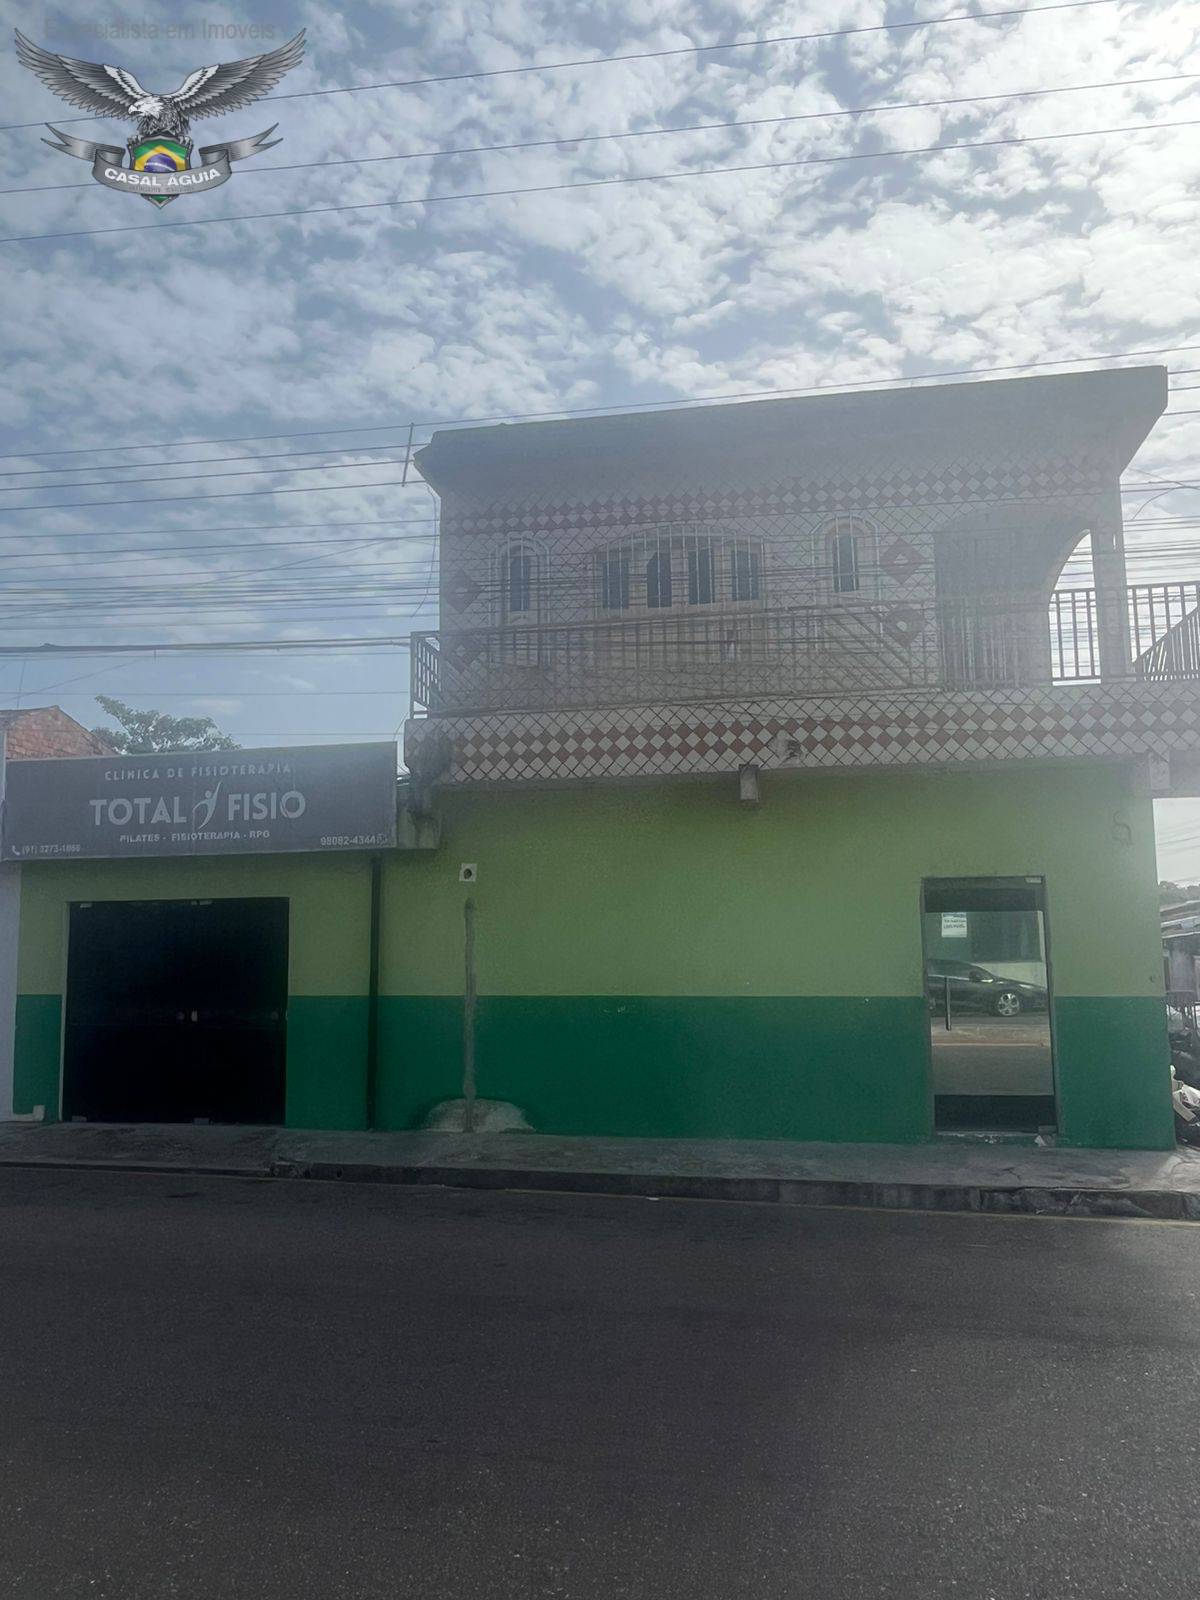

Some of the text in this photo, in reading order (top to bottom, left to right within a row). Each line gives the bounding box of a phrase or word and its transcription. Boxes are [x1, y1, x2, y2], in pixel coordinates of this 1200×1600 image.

[166, 767, 184, 779] DE
[191, 760, 291, 777] FISIOTERAPIA
[89, 790, 306, 826] TOTAL FISIO
[119, 830, 271, 843] PILATES FISIOTERAPIA RPG
